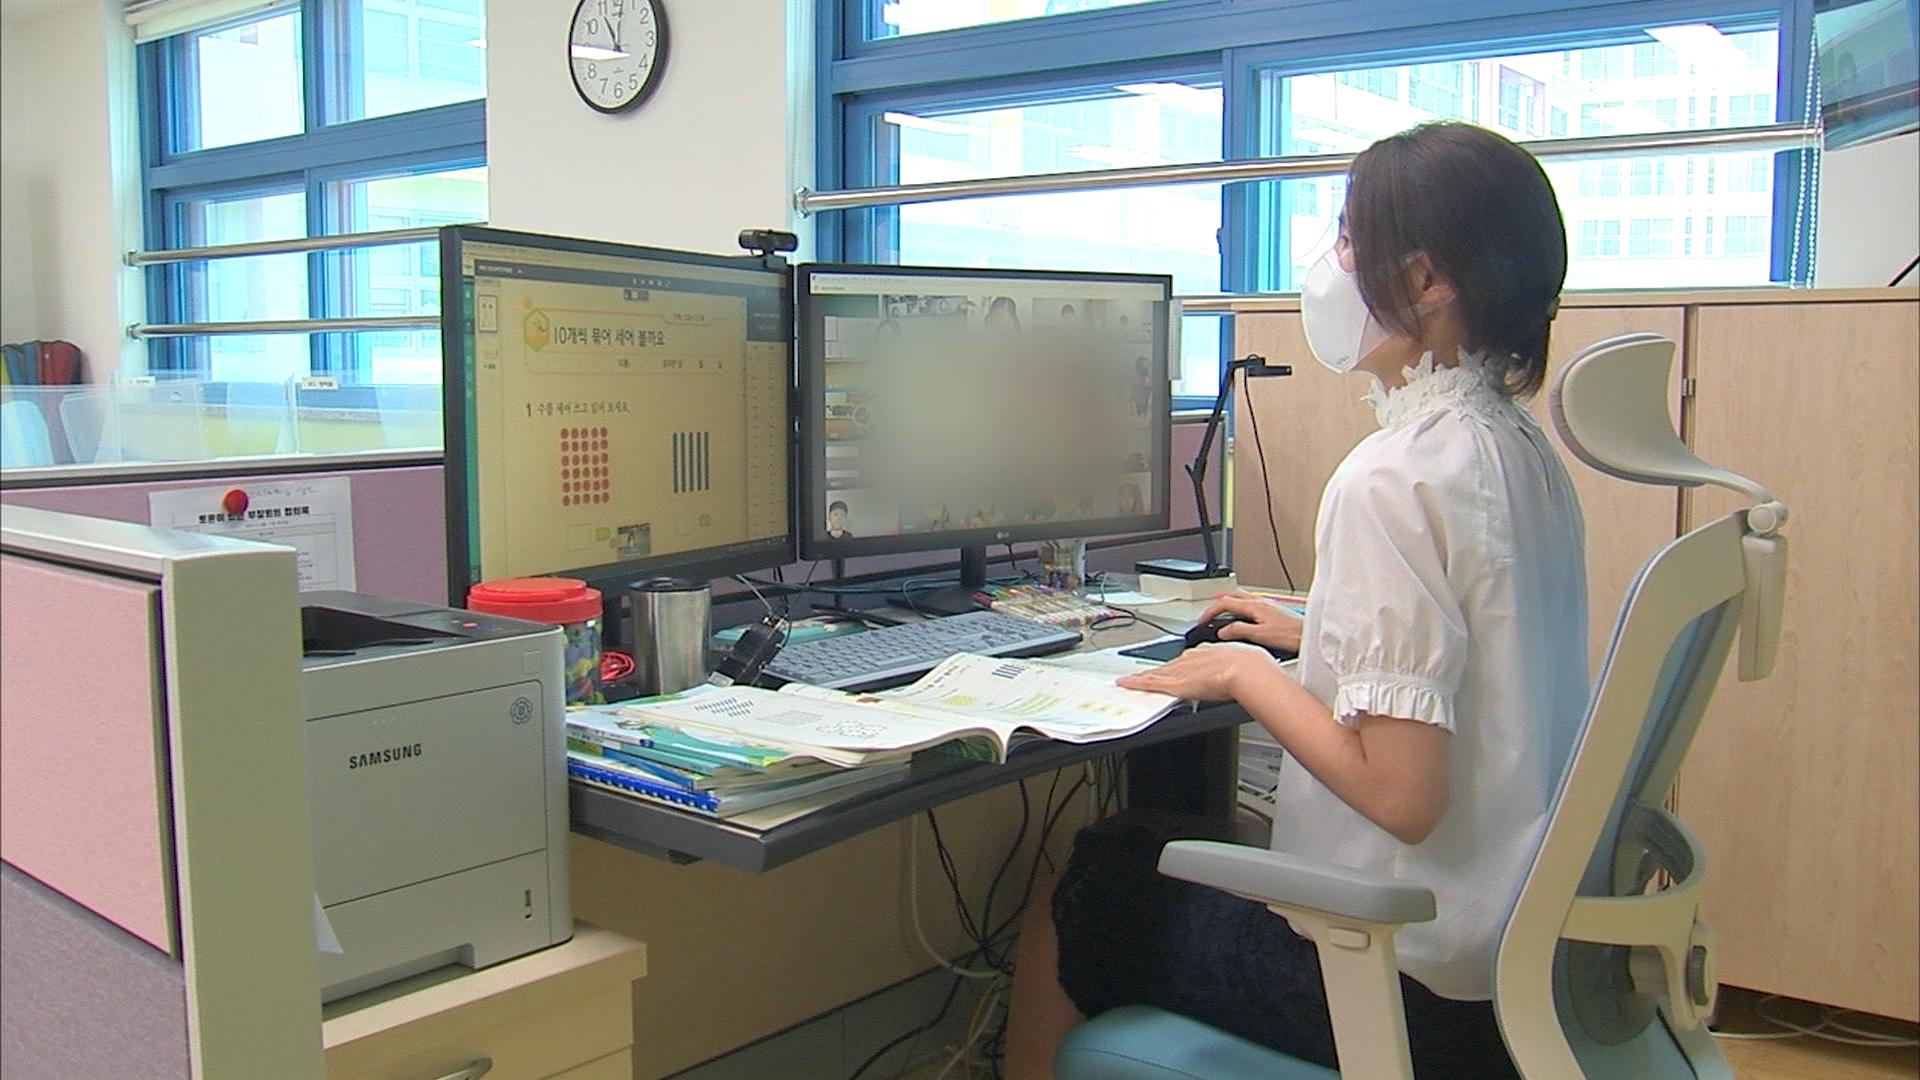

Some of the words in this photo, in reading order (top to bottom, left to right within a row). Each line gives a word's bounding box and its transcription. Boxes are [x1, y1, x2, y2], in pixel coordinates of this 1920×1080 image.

[640, 7, 649, 25] 2
[586, 18, 599, 35] 10
[645, 31, 655, 47] 3
[588, 63, 597, 79] 8
[638, 54, 649, 71] 4
[600, 78, 609, 94] 7
[628, 73, 638, 90] 5
[613, 82, 623, 99] 6
[554, 326, 588, 345] 10개씩
[591, 327, 611, 346] 묶어
[615, 328, 634, 347] 세어
[637, 330, 666, 347] 볼까요
[526, 402, 532, 417] 1
[537, 402, 553, 417] 수를
[557, 401, 571, 415] 세어
[573, 402, 588, 414] 쓰고
[349, 743, 423, 769] SAMSUNG
